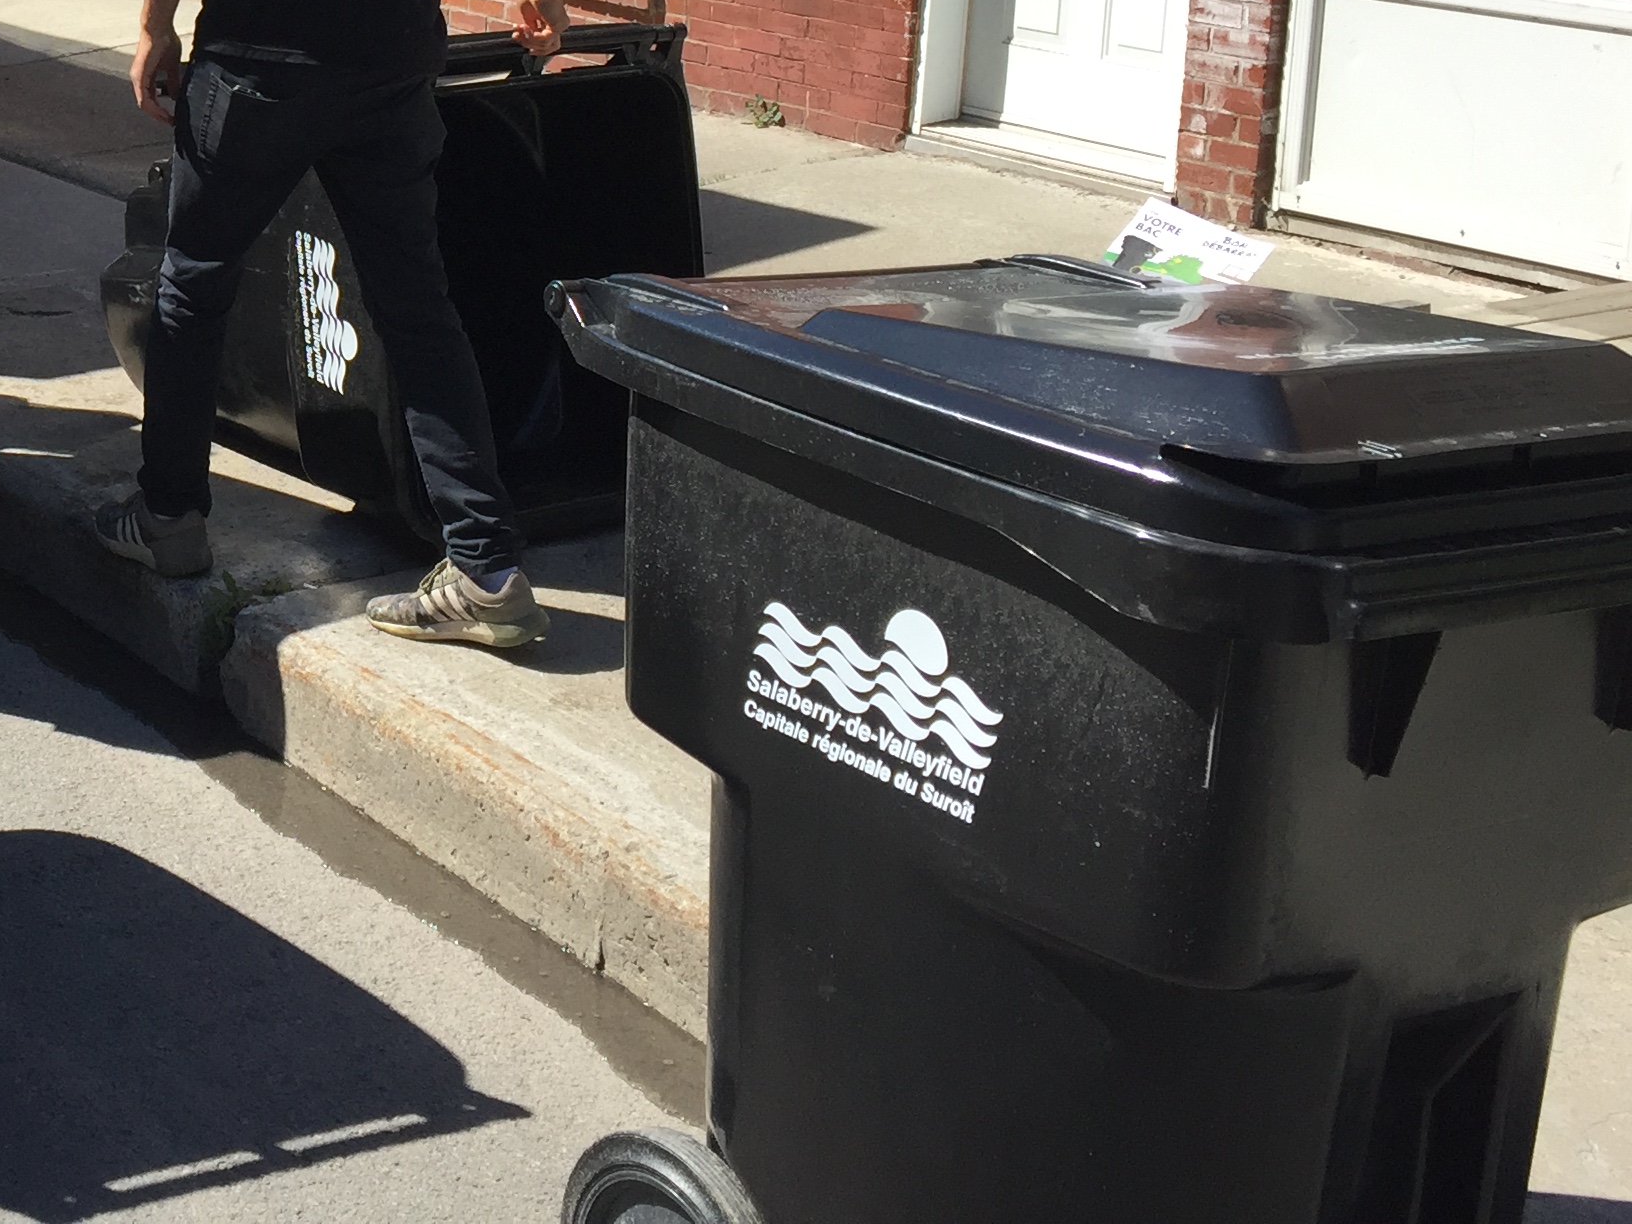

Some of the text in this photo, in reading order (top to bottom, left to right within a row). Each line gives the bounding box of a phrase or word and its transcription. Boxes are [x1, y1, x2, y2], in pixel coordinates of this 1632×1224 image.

[1135, 222, 1162, 238] BAC
[1143, 213, 1184, 237] VOTRE
[1222, 236, 1248, 248] BON
[746, 668, 986, 797] Salaberry-de-Valleyfield
[743, 698, 976, 824] Capitale régionale du Suroît
